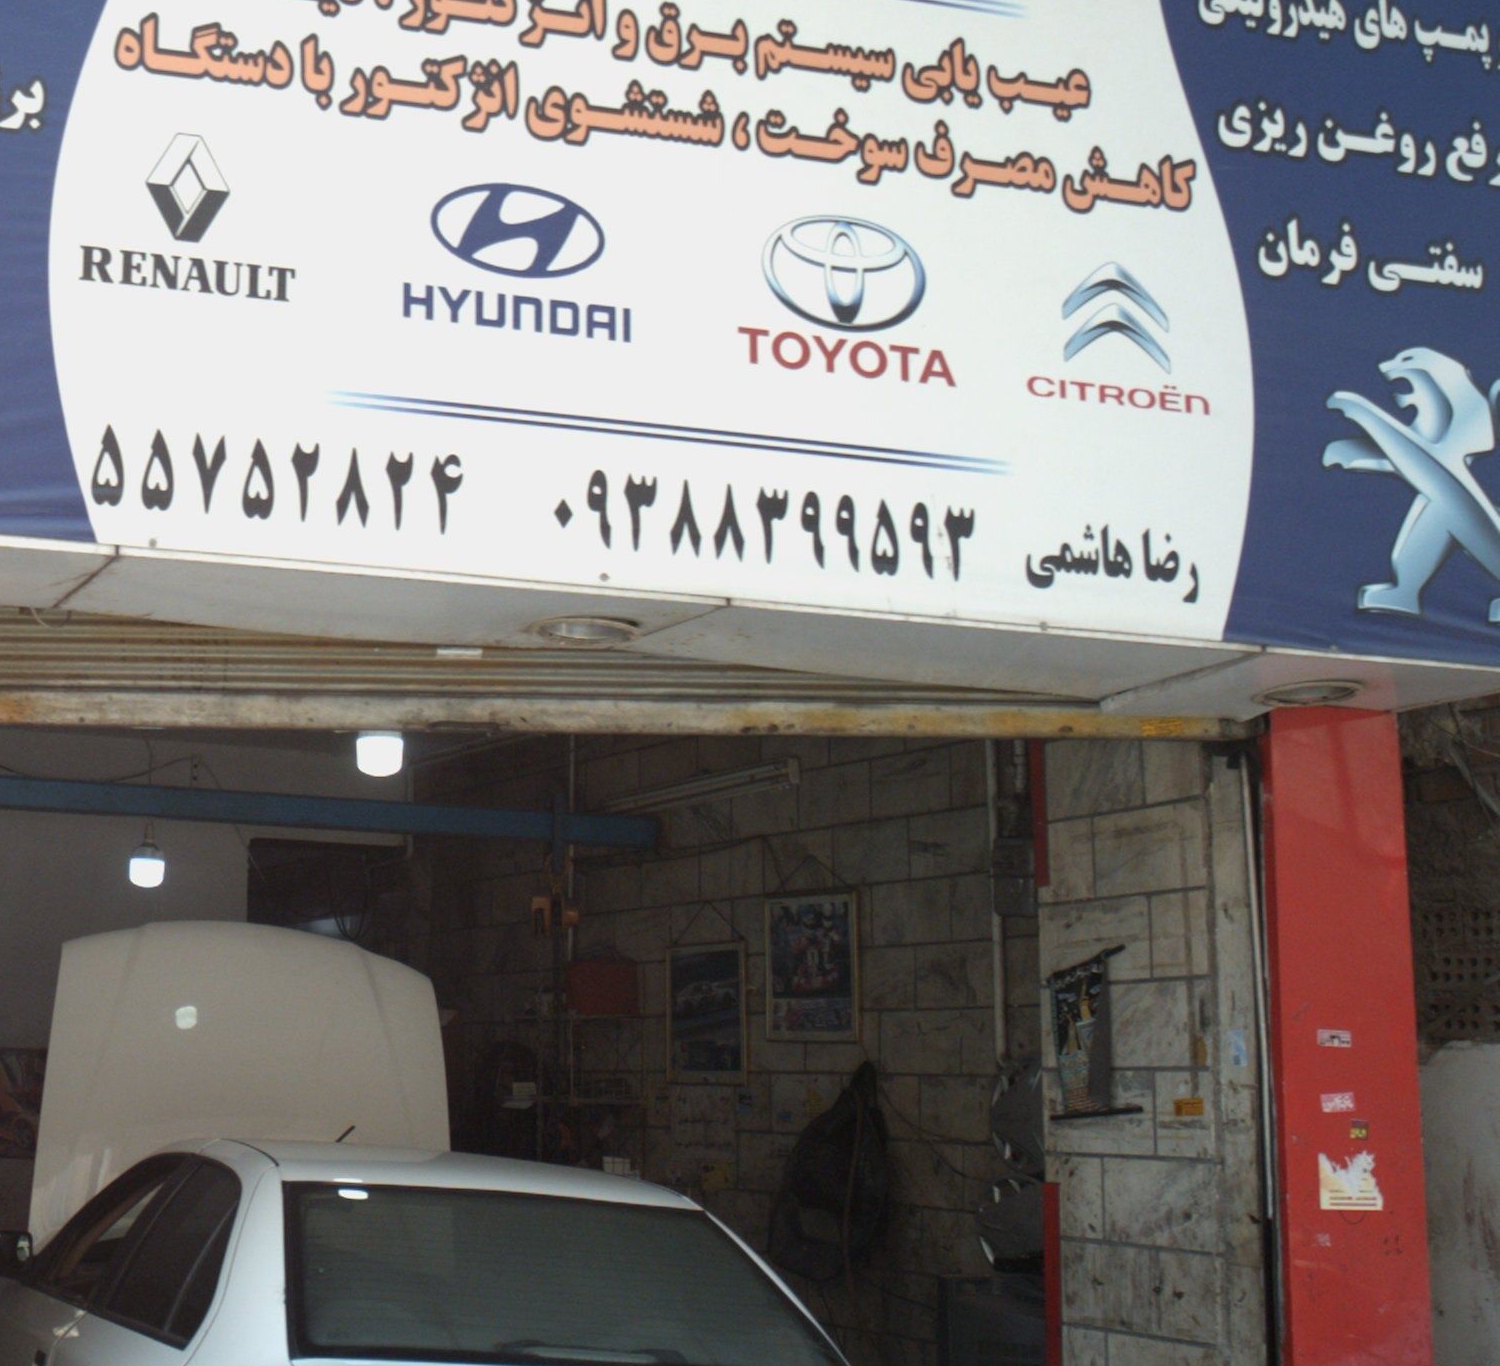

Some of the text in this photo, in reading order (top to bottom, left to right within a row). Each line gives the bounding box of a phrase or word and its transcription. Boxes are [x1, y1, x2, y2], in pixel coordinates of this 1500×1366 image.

[113, 11, 294, 89] دستگاه
[611, 6, 639, 61] و
[645, 1, 748, 75] برق
[754, 17, 896, 92] سیستم
[1414, 19, 1493, 71] پمپ
[300, 33, 334, 110] با
[339, 54, 519, 134] انژکتور
[902, 36, 981, 110] یابی
[986, 67, 1092, 122] عیب
[524, 79, 724, 148] شستشوی
[756, 107, 909, 184] سوخت
[1216, 99, 1309, 160] ریزی
[1316, 110, 1438, 178] روغن
[914, 119, 1057, 199] مصرف
[1062, 143, 1197, 214] کاهش
[78, 243, 298, 304] RENAULT
[1257, 217, 1485, 293] سفتی فرمان
[402, 281, 633, 343] HYUNDAI
[736, 325, 958, 389] TOYOTA
[1025, 373, 1212, 418] CITROËN
[90, 422, 465, 535] ۵۵۷۵۲۸۲۴
[552, 468, 1200, 604] رضا هاشمی ۰۹۳۸۸۳۹۹۵۹۳
